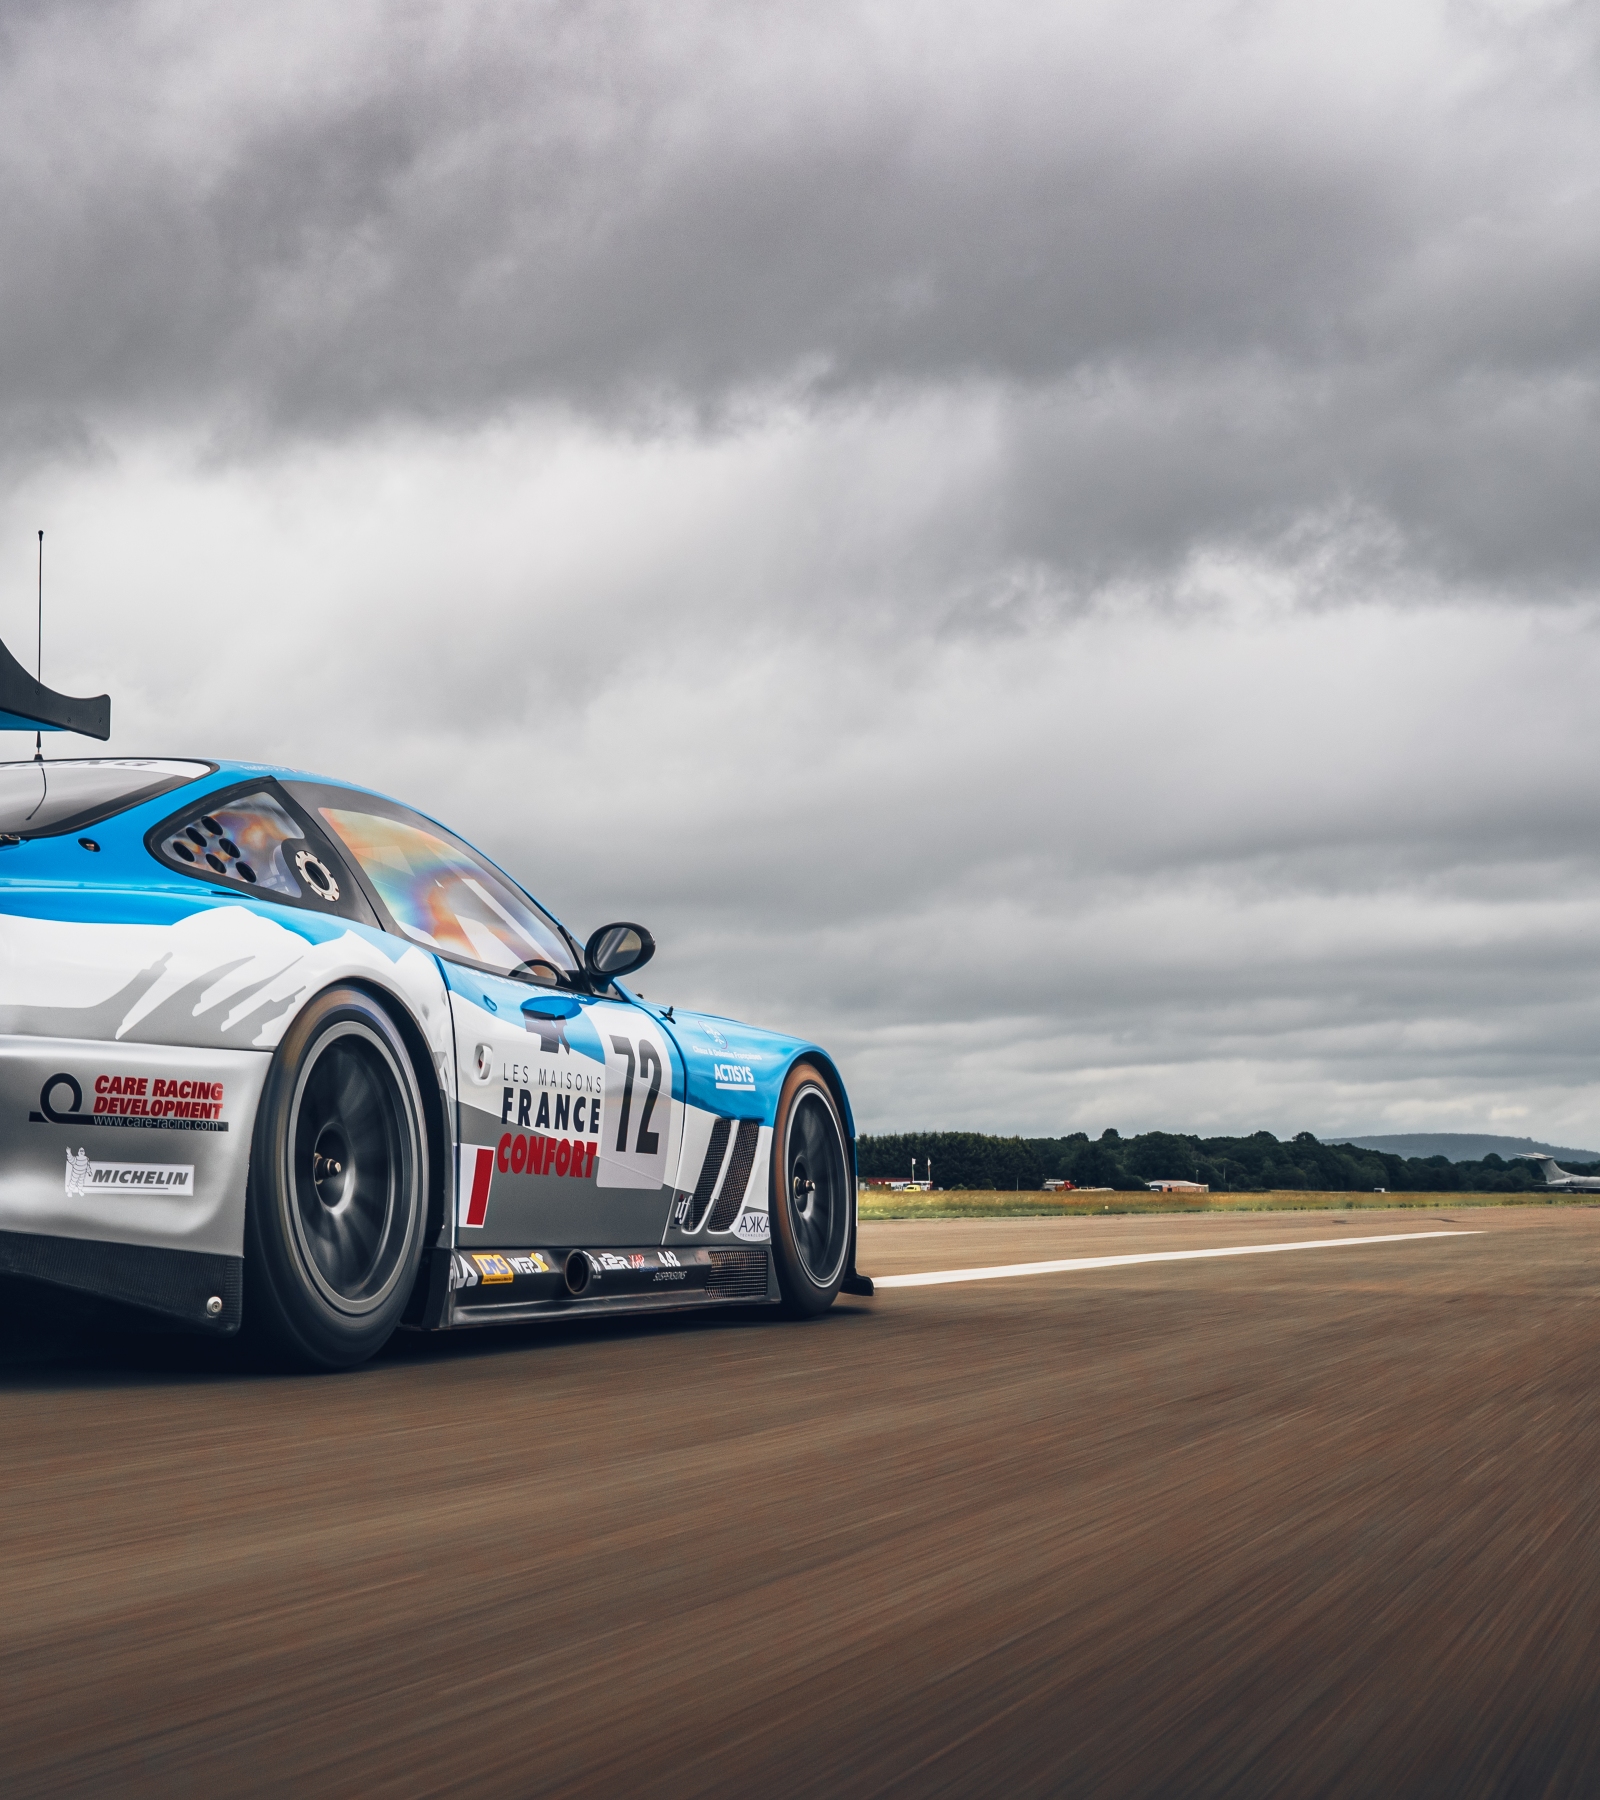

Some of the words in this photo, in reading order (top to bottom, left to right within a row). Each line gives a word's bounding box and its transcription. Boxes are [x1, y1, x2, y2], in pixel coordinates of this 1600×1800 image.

[503, 1062, 529, 1084] LES
[538, 1068, 602, 1094] MAISONS
[714, 1063, 754, 1083] ACTISYS
[94, 1075, 148, 1096] CARE
[152, 1078, 224, 1101] RACING
[608, 1034, 663, 1155] 72
[93, 1096, 223, 1119] DEVELOPMENT
[501, 1087, 601, 1134] FRANCE
[93, 1115, 219, 1131] www.care-racing.com
[497, 1132, 598, 1178] CONFORT
[92, 1169, 189, 1185] MICHELIN
[477, 1257, 509, 1275] LMS
